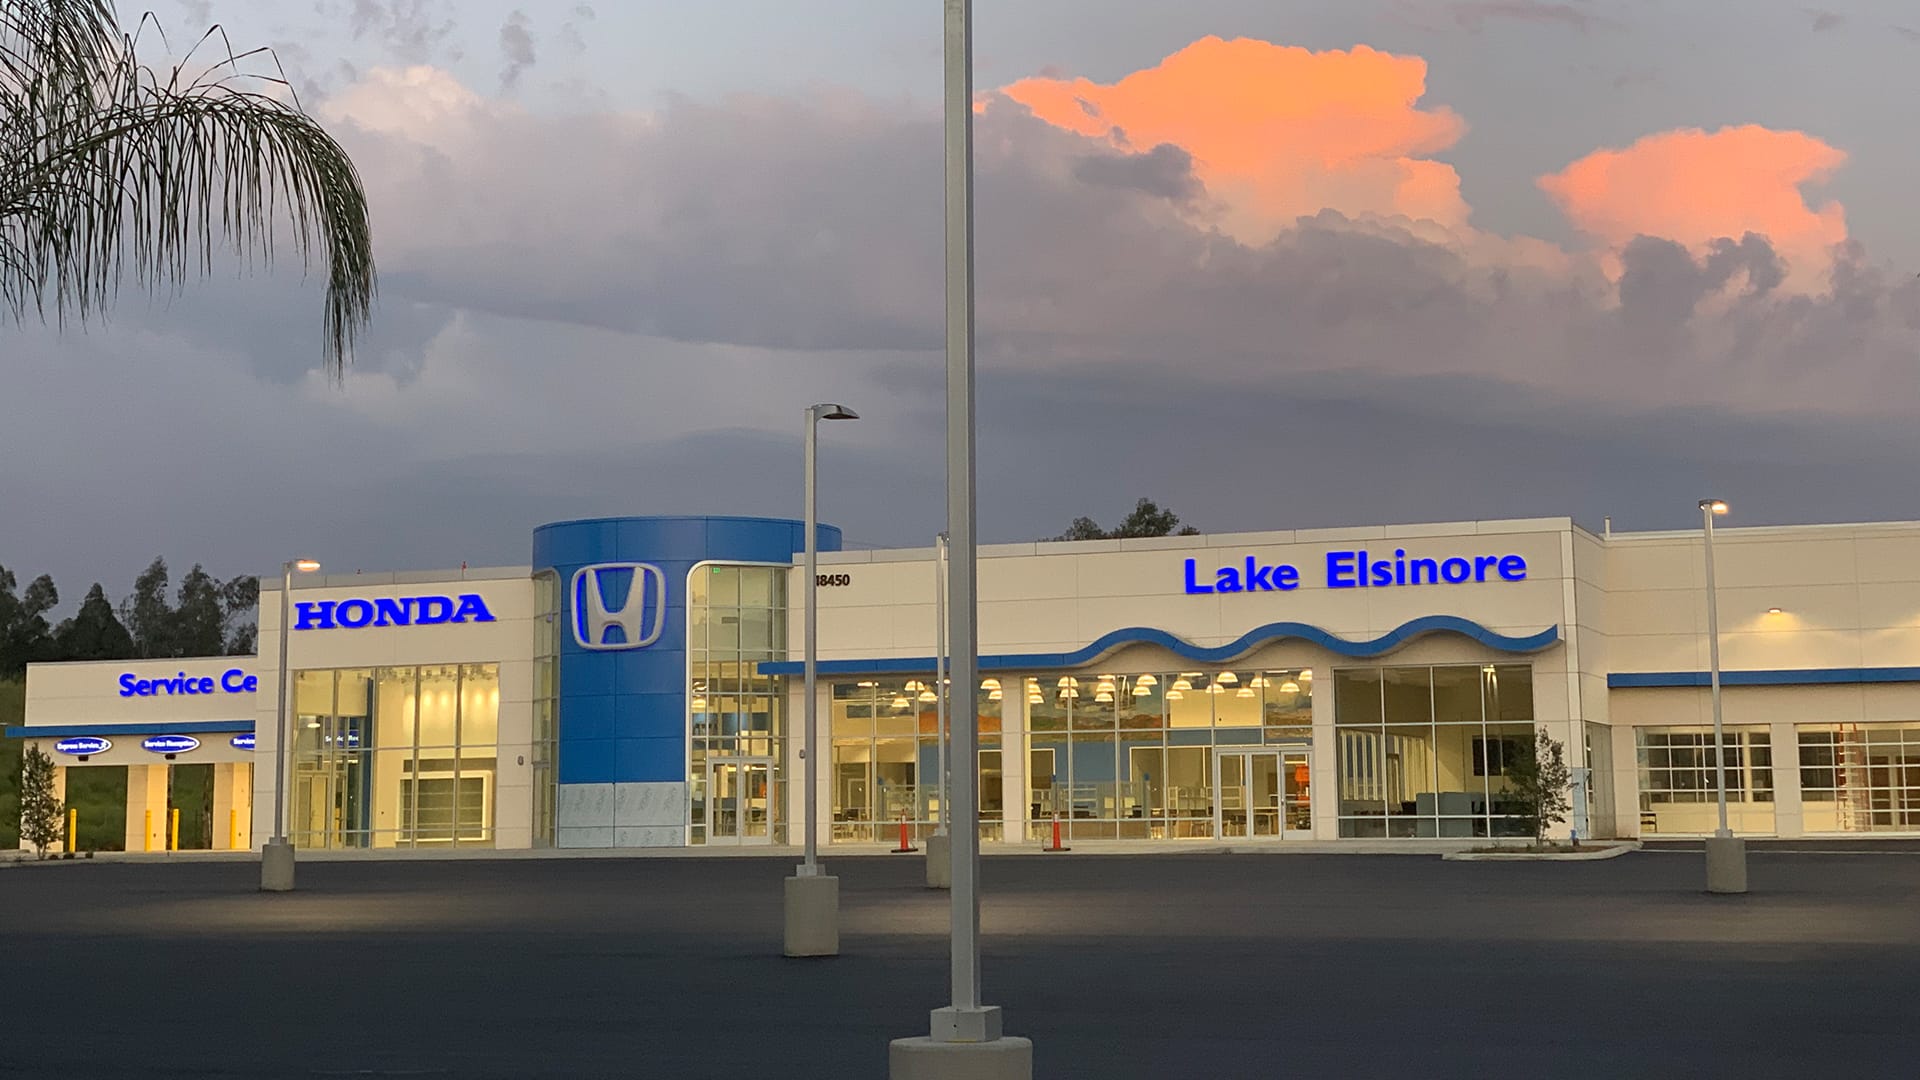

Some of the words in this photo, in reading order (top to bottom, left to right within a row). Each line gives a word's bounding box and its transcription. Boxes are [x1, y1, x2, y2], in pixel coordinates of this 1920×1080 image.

[1185, 556, 1299, 595] Lake
[1326, 549, 1527, 589] Elsinore
[294, 593, 495, 630] HONDA
[119, 671, 214, 697] Service
[144, 740, 166, 748] Service
